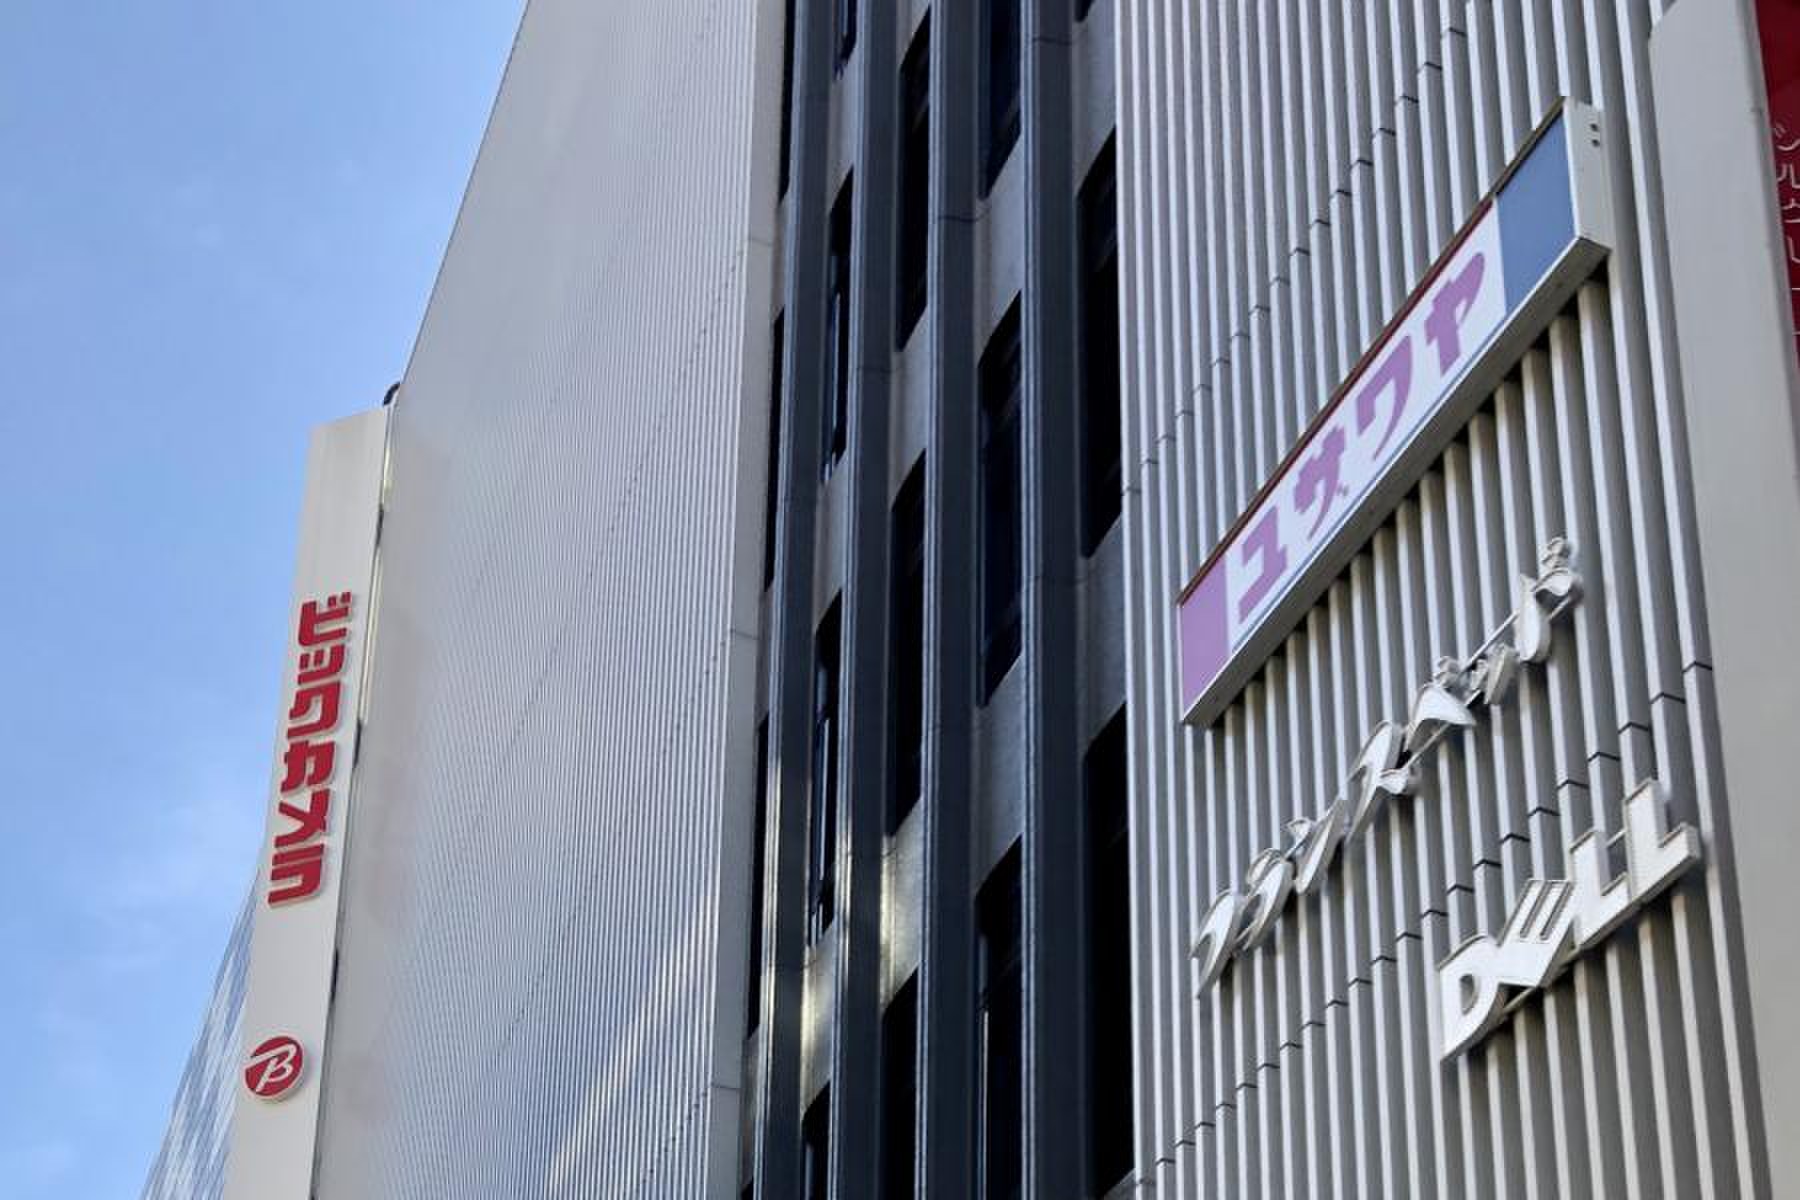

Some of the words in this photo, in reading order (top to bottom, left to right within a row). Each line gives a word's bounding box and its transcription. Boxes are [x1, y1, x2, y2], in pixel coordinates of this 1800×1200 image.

[1238, 251, 1487, 624] ユザワヤ
[267, 591, 352, 905] ビックカメラ
[1438, 778, 1704, 1061] DELL
